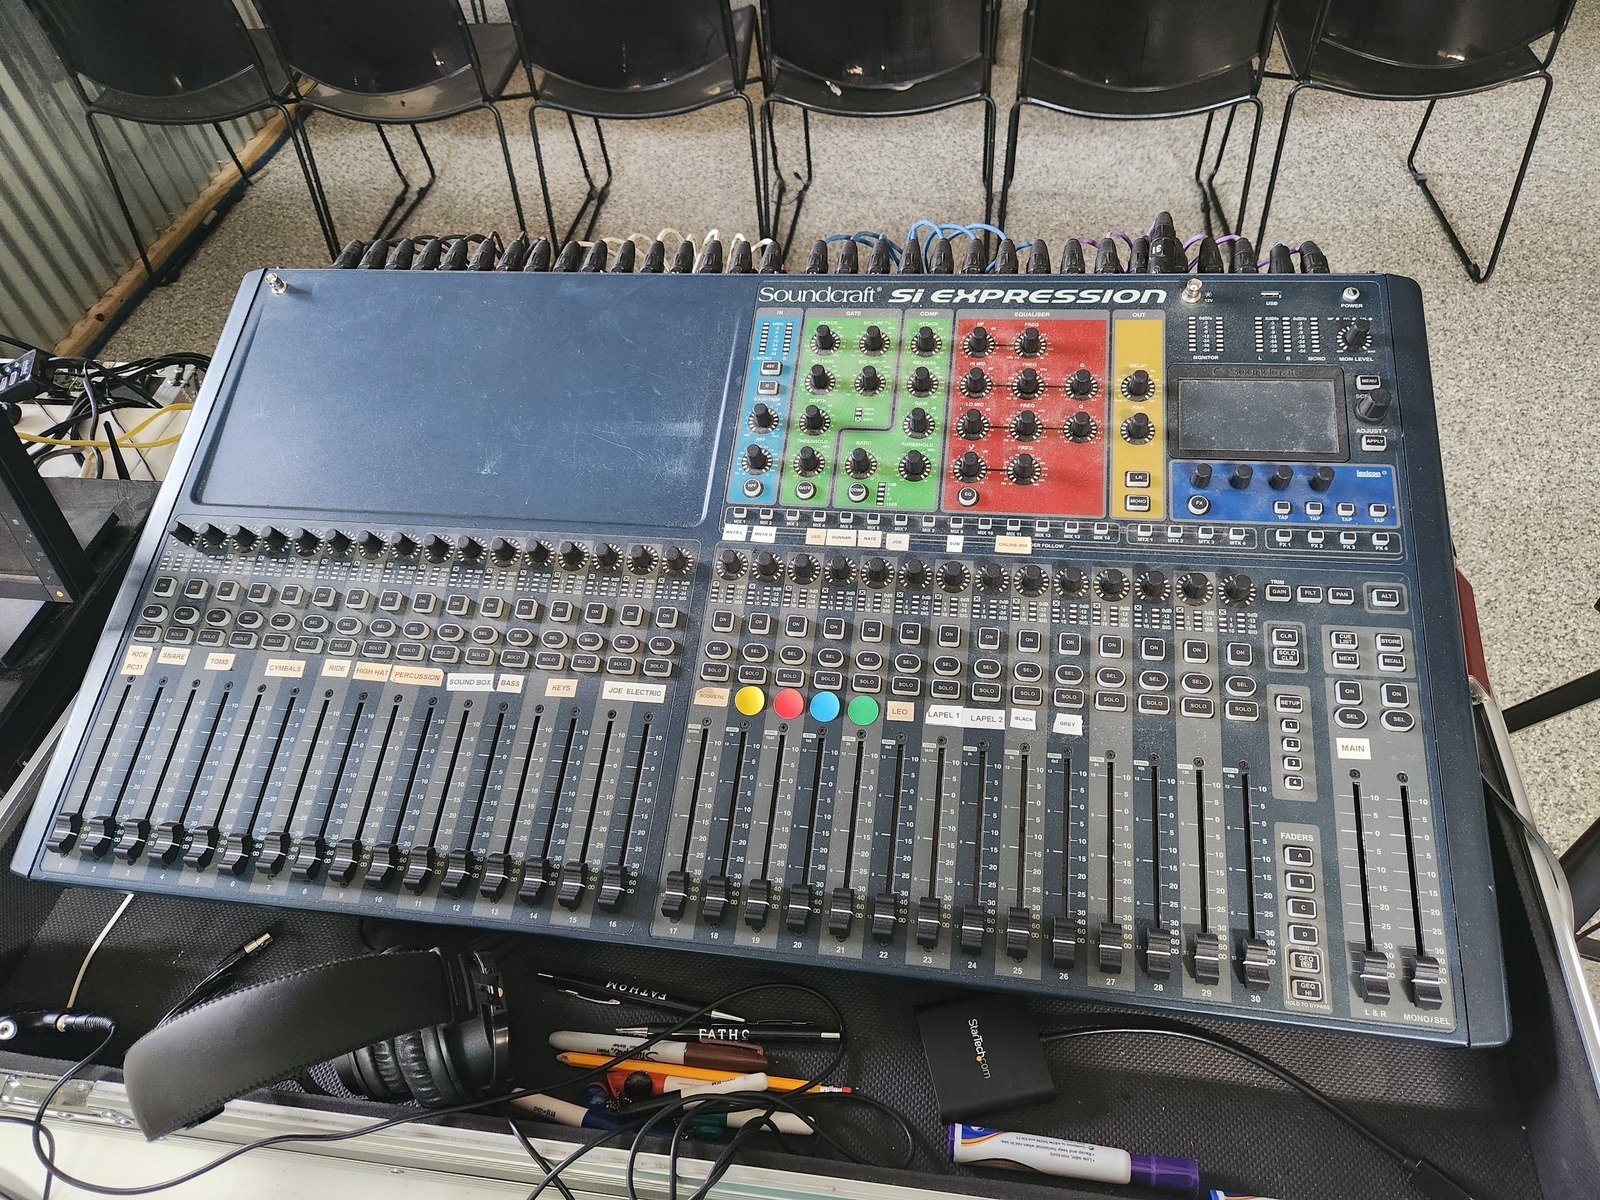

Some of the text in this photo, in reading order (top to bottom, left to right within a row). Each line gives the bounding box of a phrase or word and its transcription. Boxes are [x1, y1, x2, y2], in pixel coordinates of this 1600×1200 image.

[888, 289, 1167, 303] Si EXPRESSION
[395, 672, 440, 680] PERCUSSION
[1280, 832, 1314, 841] FADERS
[606, 981, 667, 1001] FATHOM
[1404, 1013, 1451, 1024] MONO/SEL
[968, 1018, 990, 1080] StarTech.com
